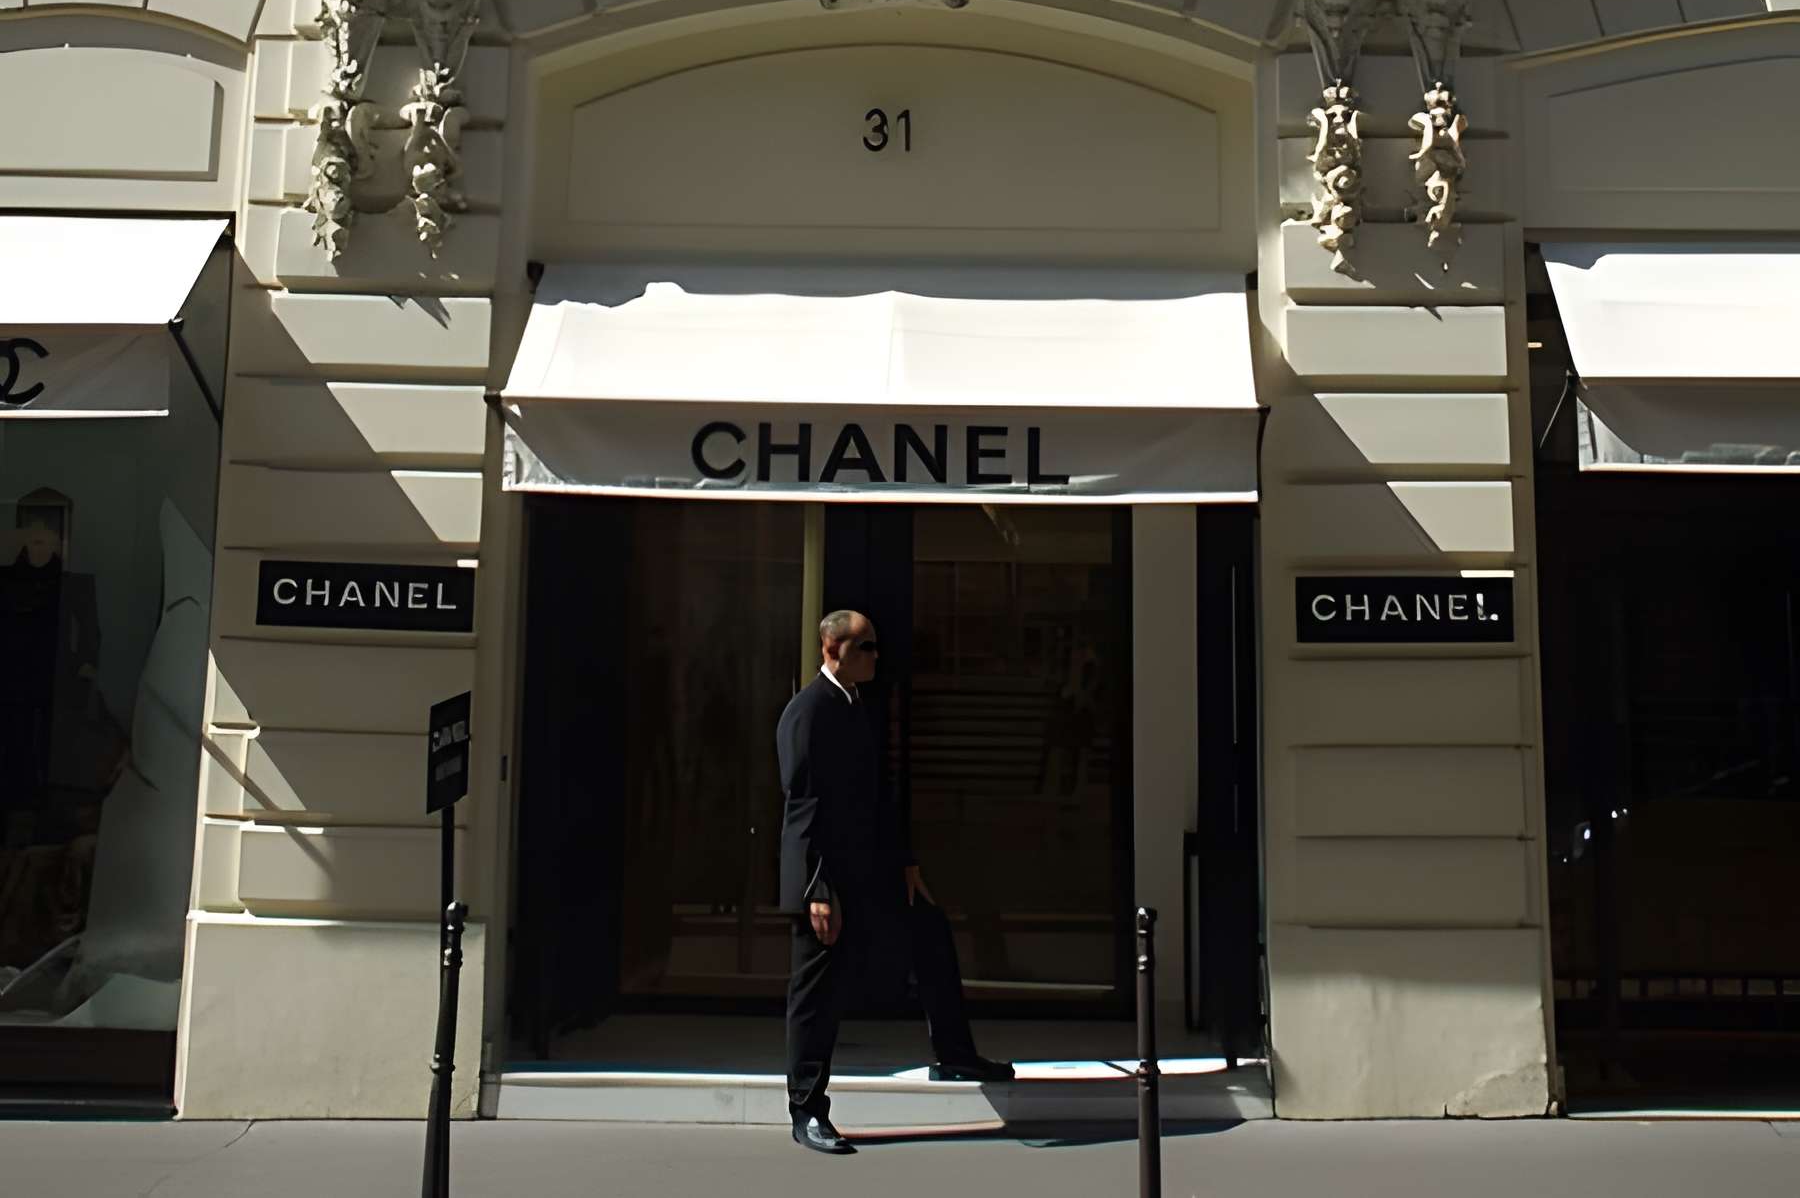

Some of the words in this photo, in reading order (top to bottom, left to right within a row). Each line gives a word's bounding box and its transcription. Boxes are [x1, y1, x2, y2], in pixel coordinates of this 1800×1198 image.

[862, 107, 912, 153] 31
[691, 420, 1070, 484] CHANEL
[273, 577, 457, 610] CHANEL
[1311, 592, 1499, 621] CHANEL
